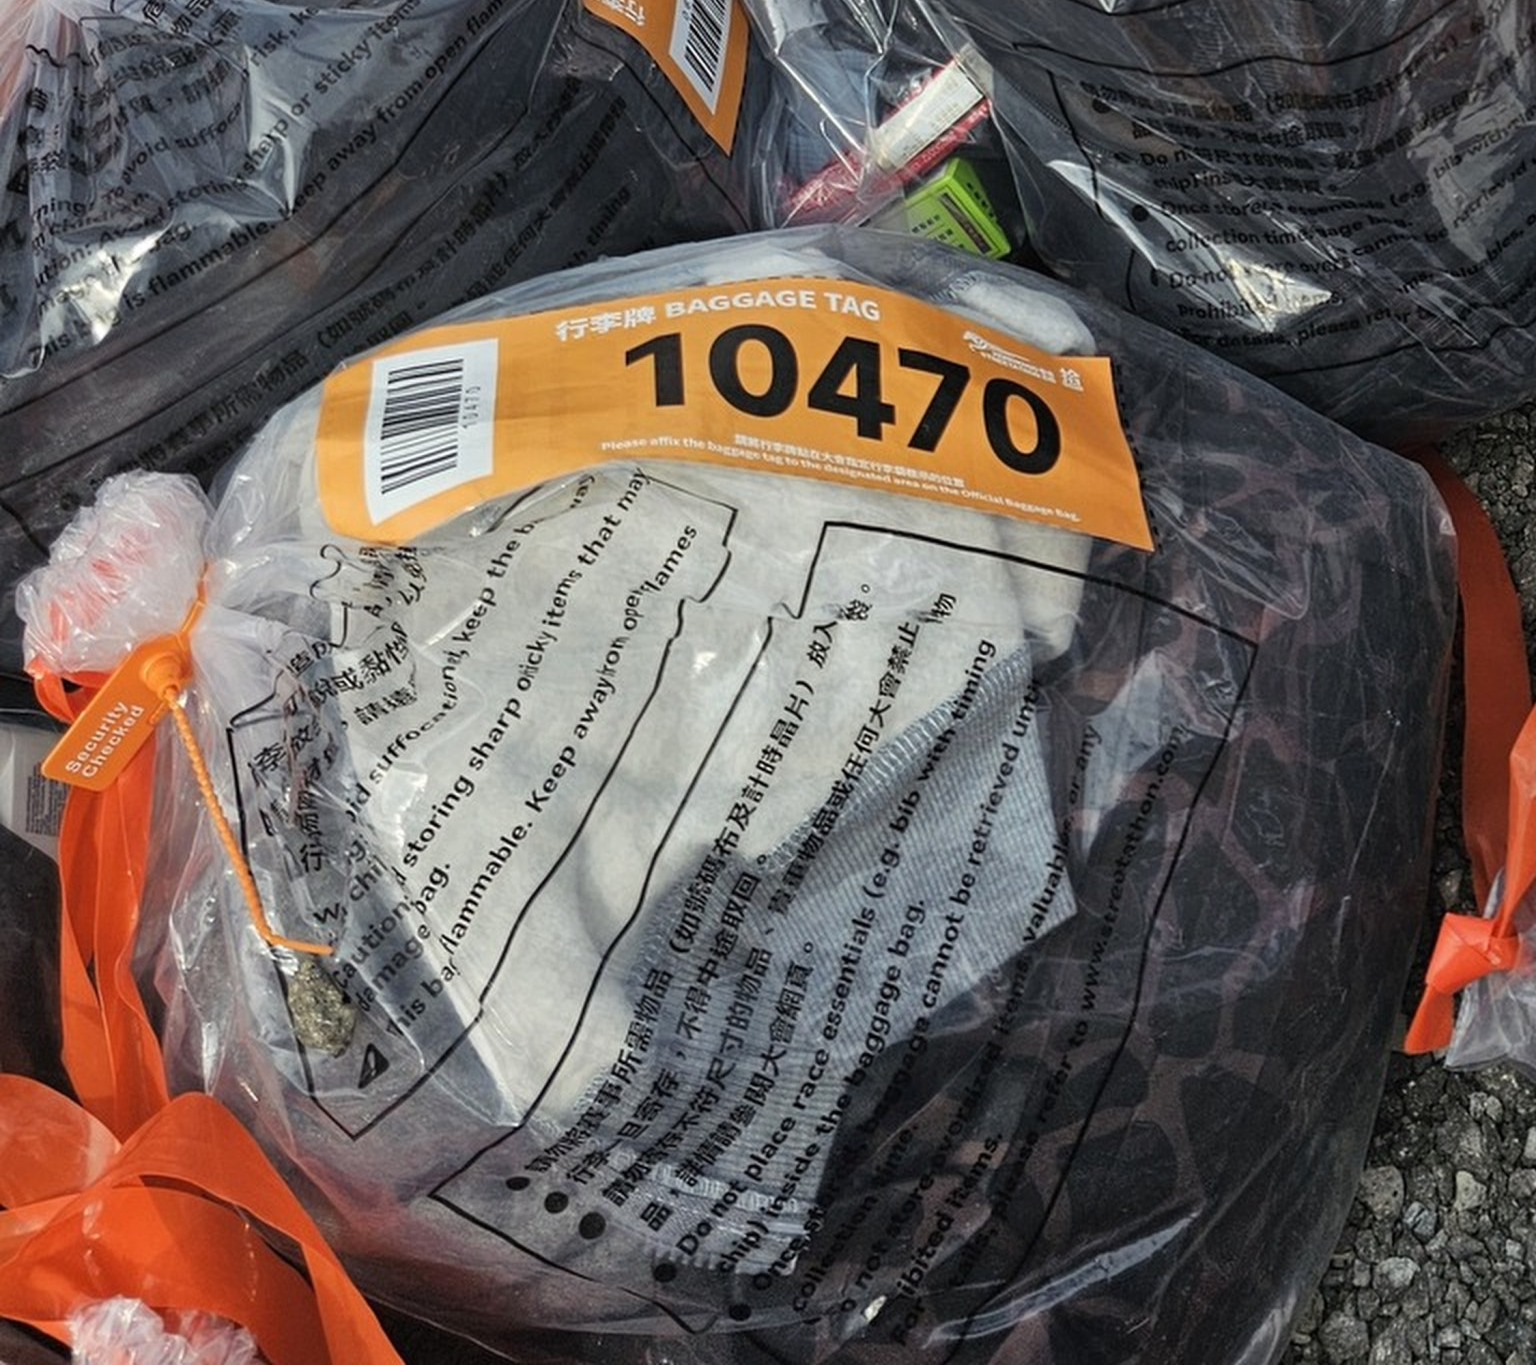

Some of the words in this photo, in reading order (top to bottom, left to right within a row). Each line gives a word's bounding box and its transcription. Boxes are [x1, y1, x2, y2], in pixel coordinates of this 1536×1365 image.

[290, 92, 314, 118] or
[314, 34, 374, 95] sticky
[146, 220, 277, 301] flammable.
[377, 79, 425, 127] from
[423, 39, 466, 81] open
[553, 303, 657, 342] 行李牌
[663, 289, 818, 321] BAGGAGE
[822, 291, 881, 323] TAG
[461, 384, 483, 432] 10470
[624, 322, 1063, 476] 10470
[488, 537, 519, 581] the
[402, 772, 475, 870] storing
[468, 696, 523, 771] sharp
[543, 567, 583, 639] items
[577, 511, 621, 569] that
[619, 468, 651, 512] may
[65, 701, 130, 774] Security
[81, 704, 145, 778] Checked
[527, 746, 577, 814] Keep
[967, 741, 1021, 870] retrieved
[959, 873, 976, 910] be
[675, 1232, 701, 1258] Do
[709, 1181, 748, 1226] not
[744, 1117, 798, 1182] place
[794, 1048, 831, 1110] race
[820, 905, 876, 1042] essentials
[862, 840, 899, 901] (e.g.
[890, 790, 921, 835] bib
[917, 728, 956, 783] with
[951, 638, 997, 722] timing
[922, 901, 963, 1009] cannot
[769, 1131, 823, 1220] inside
[818, 1084, 854, 1139] the
[850, 962, 901, 1084] baggage
[898, 899, 925, 960] bag.
